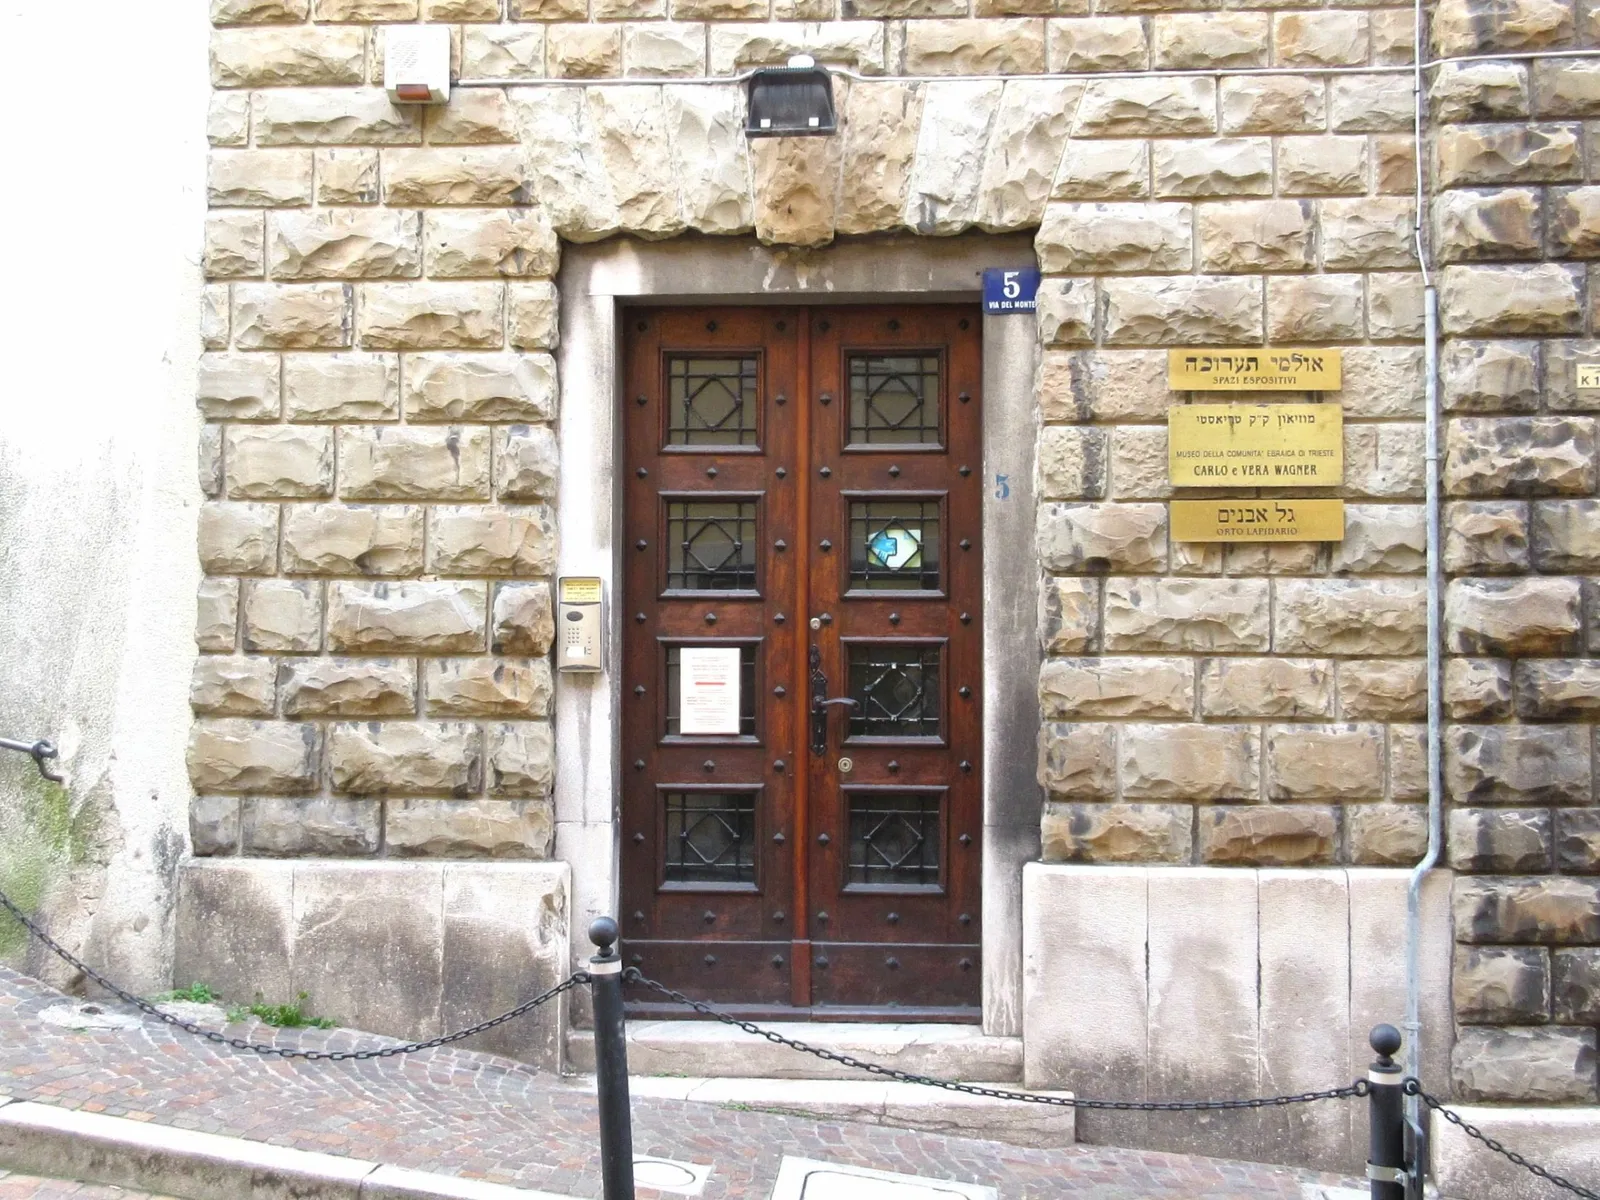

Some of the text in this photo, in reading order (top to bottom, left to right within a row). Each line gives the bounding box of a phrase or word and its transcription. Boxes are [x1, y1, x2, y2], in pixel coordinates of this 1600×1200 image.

[1003, 271, 1020, 298] 5
[989, 300, 1036, 309] VIA DEL MONTE
[1185, 353, 1323, 374] אולמי תערוכה
[1213, 376, 1297, 384] SPAZI ESPOSITIVI
[1277, 414, 1315, 426] מוזיאון
[1176, 450, 1201, 458] MUSEO
[1203, 450, 1224, 458] DELLA
[1194, 464, 1317, 476] CARLO e VERA WAGNER
[1218, 503, 1296, 523] גל אבנים
[1216, 527, 1298, 536] ORTO LAPIDARIO
